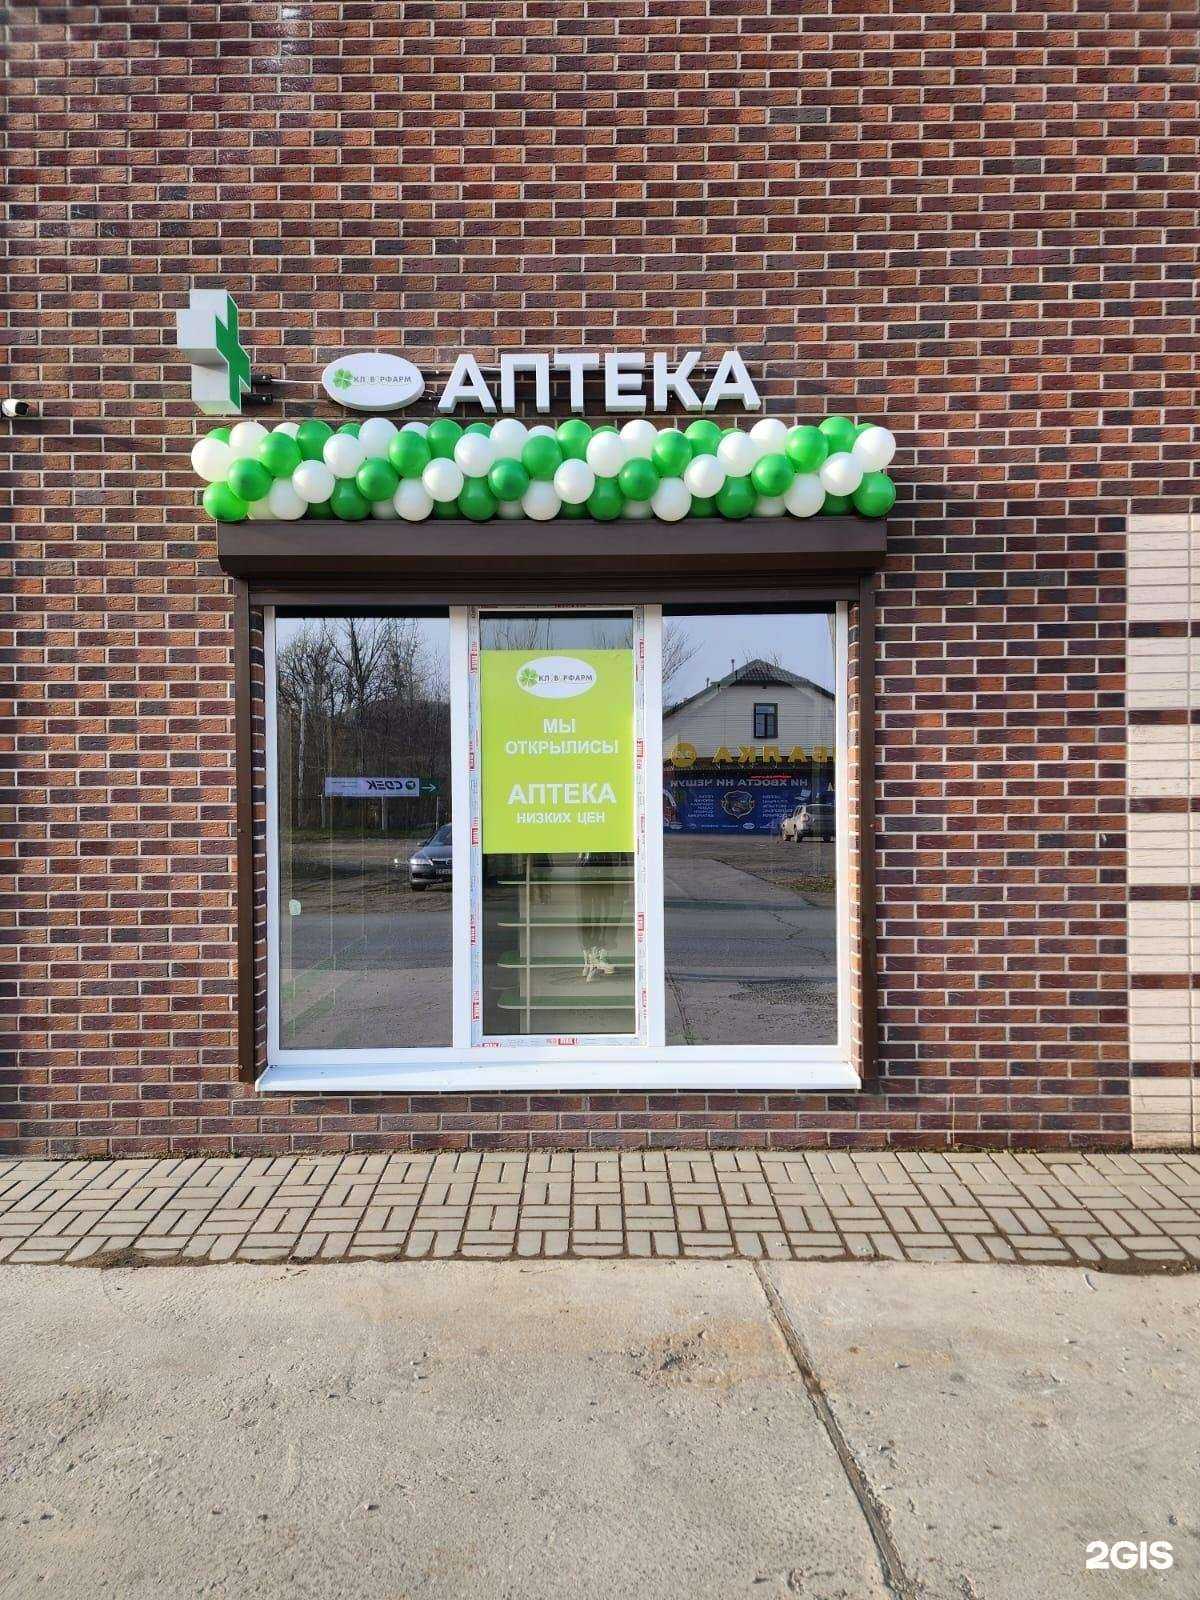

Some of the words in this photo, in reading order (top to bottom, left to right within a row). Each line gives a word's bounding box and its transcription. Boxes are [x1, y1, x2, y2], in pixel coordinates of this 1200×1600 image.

[353, 375, 412, 384] КЛВРФАРМ
[438, 351, 761, 413] АПТЕКА
[538, 673, 593, 683] КЛВРФАРМ
[543, 718, 576, 734] МЫ
[506, 782, 617, 805] АПТЕКА
[516, 811, 571, 824] НИЗКИХ
[577, 811, 605, 825] ЦЕН
